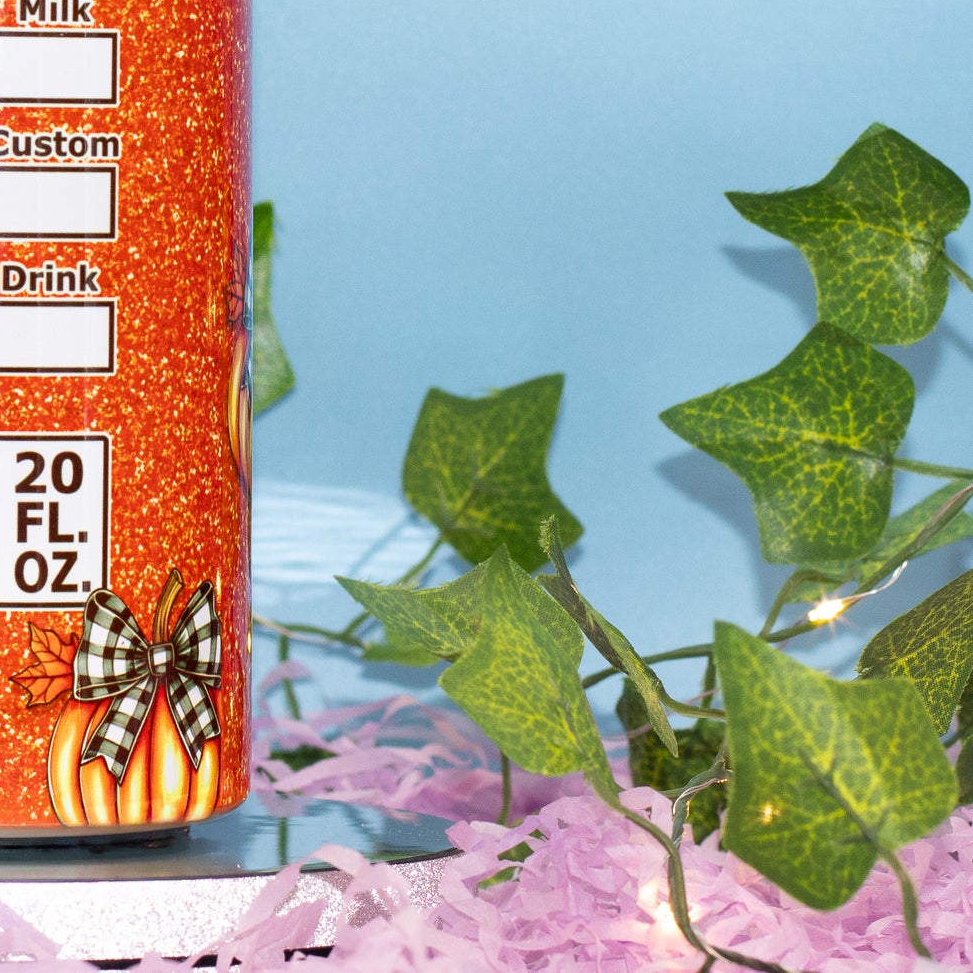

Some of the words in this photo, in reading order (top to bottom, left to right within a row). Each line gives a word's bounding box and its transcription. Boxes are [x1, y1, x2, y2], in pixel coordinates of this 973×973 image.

[2, 264, 99, 292] Drink
[15, 451, 83, 494] 20
[16, 501, 88, 543] FL.
[14, 550, 91, 593] OZ.
